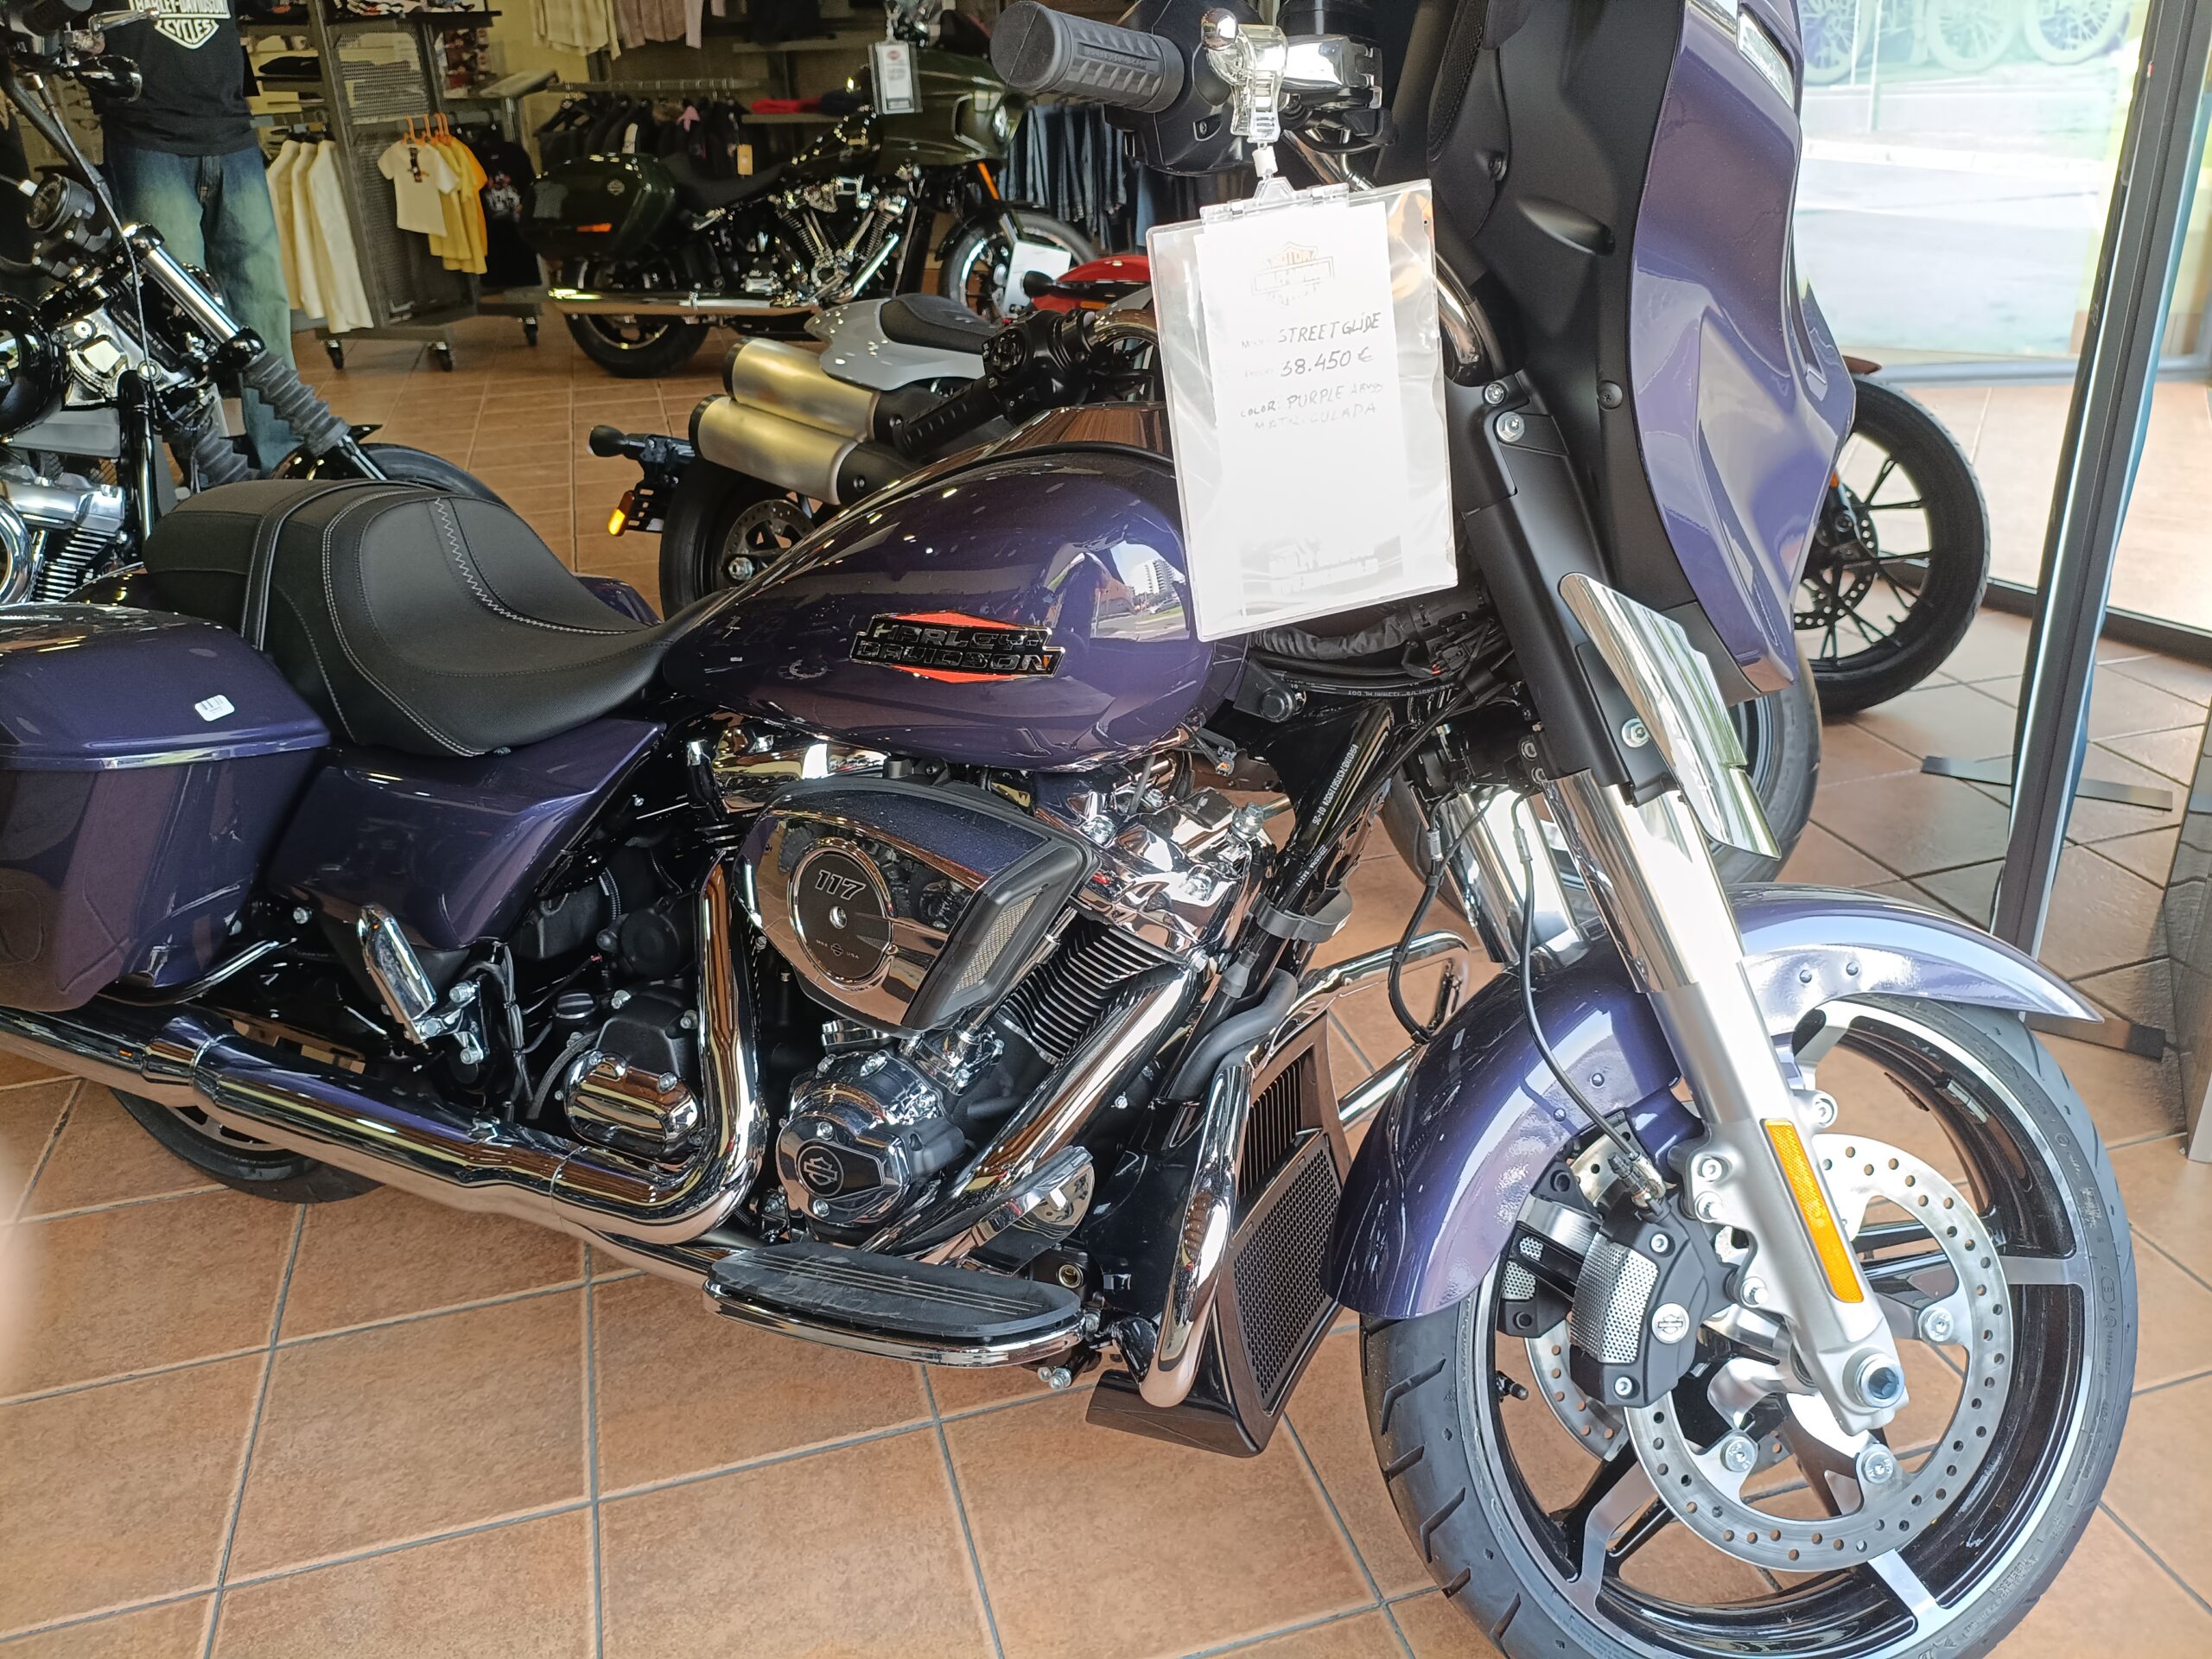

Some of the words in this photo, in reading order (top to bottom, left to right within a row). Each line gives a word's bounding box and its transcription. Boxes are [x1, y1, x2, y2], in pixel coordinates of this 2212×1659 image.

[163, 19, 212, 43] CYCLES
[1279, 321, 1340, 343] STREET
[1342, 312, 1382, 335] GLIDE
[1281, 349, 1352, 378] 38.450
[1357, 346, 1374, 363] €
[1287, 385, 1344, 409] PURPLE
[856, 639, 1053, 672] DAVIDSON
[815, 868, 867, 900] 117
